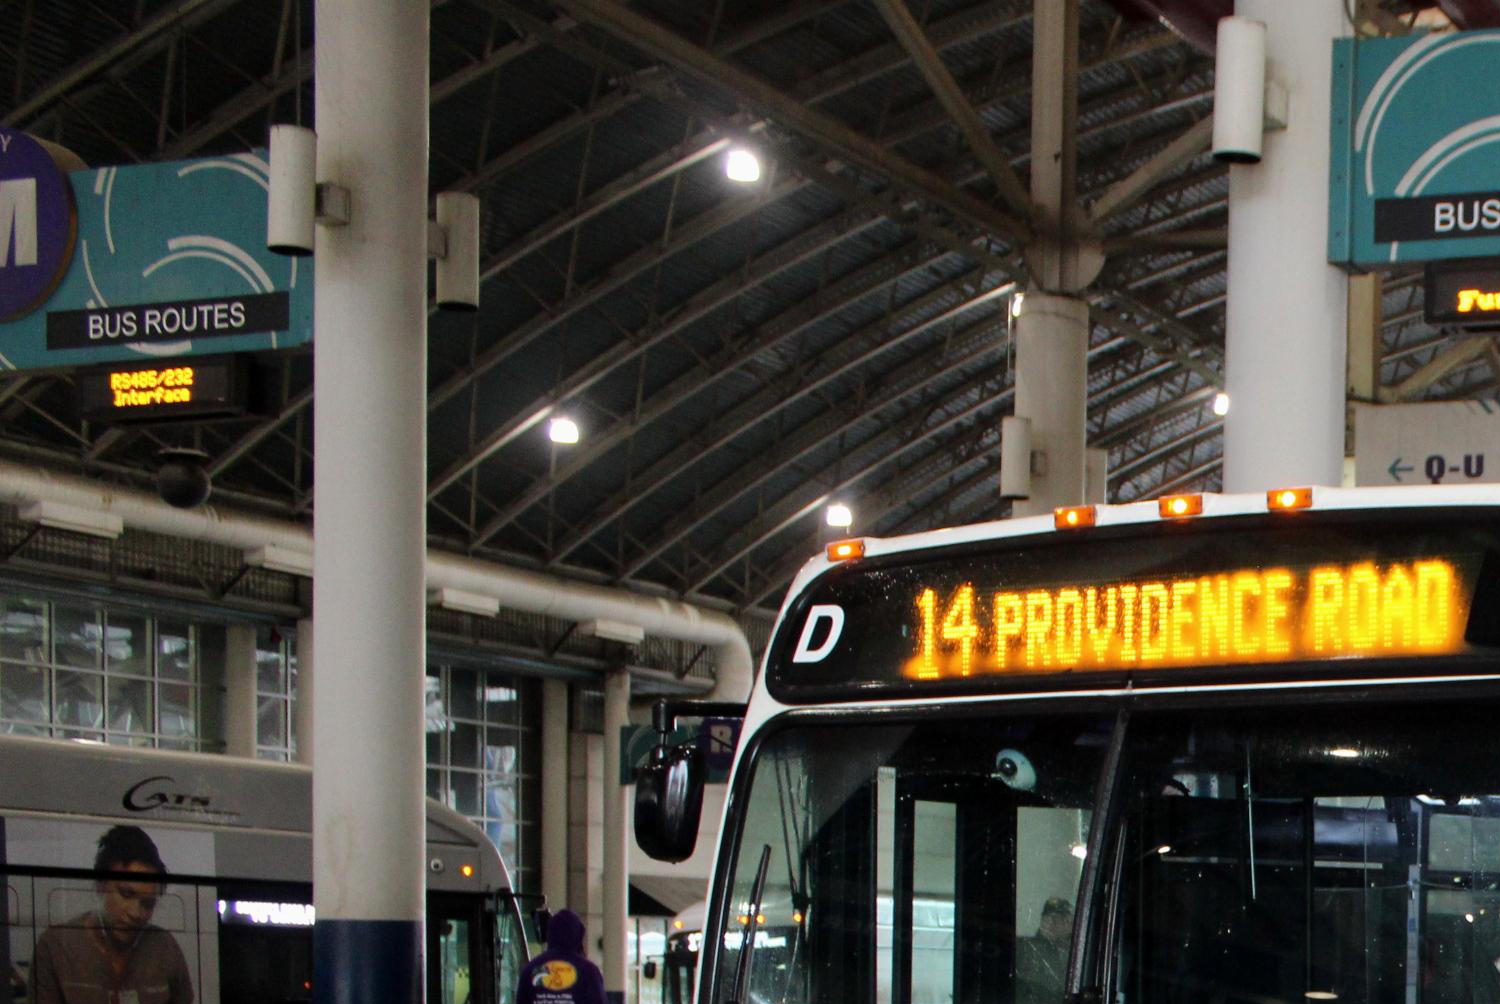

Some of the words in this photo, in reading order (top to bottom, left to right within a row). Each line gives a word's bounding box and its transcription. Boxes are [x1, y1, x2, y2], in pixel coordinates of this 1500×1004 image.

[88, 308, 138, 339] BUS
[145, 302, 246, 334] ROUTES
[111, 367, 193, 389] RS485/232
[113, 387, 191, 406] Interface
[1425, 453, 1484, 484] Q-U
[793, 603, 845, 663] D
[917, 584, 979, 679] 14
[994, 571, 1292, 669] PROVIDENCE
[1313, 559, 1453, 652] ROAD
